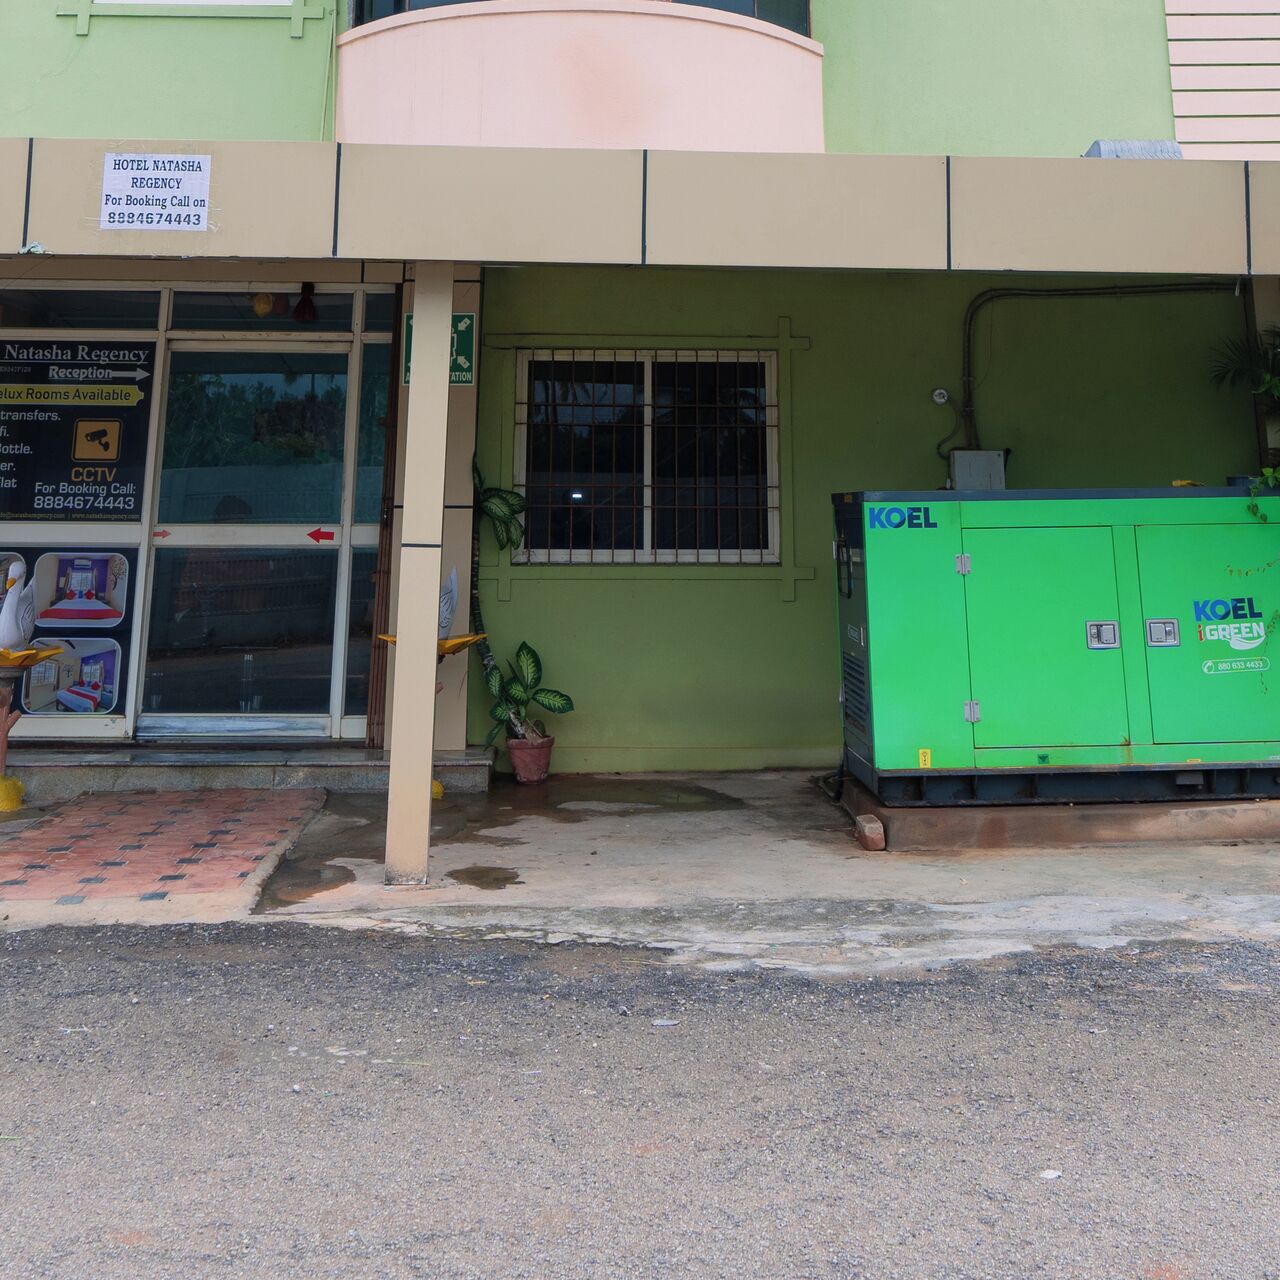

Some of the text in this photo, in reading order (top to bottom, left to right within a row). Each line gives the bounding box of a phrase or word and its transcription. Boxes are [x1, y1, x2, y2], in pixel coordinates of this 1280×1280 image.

[113, 159, 202, 172] HOTEL NATASHA
[131, 177, 182, 189] REGENCY
[104, 194, 206, 210] For Booking Call on
[107, 212, 201, 225] 8884674443
[4, 344, 71, 360] Natasha
[77, 345, 149, 365] Regency
[48, 366, 113, 381] Reception
[26, 389, 69, 400] Rooms
[72, 388, 131, 401] Available
[0, 409, 61, 421] transfers.
[71, 467, 117, 482] CCTV
[34, 482, 136, 497] For Booking Call:
[33, 496, 135, 509] 8884674443
[868, 507, 938, 528] KOEL
[1193, 597, 1263, 622] KOEL
